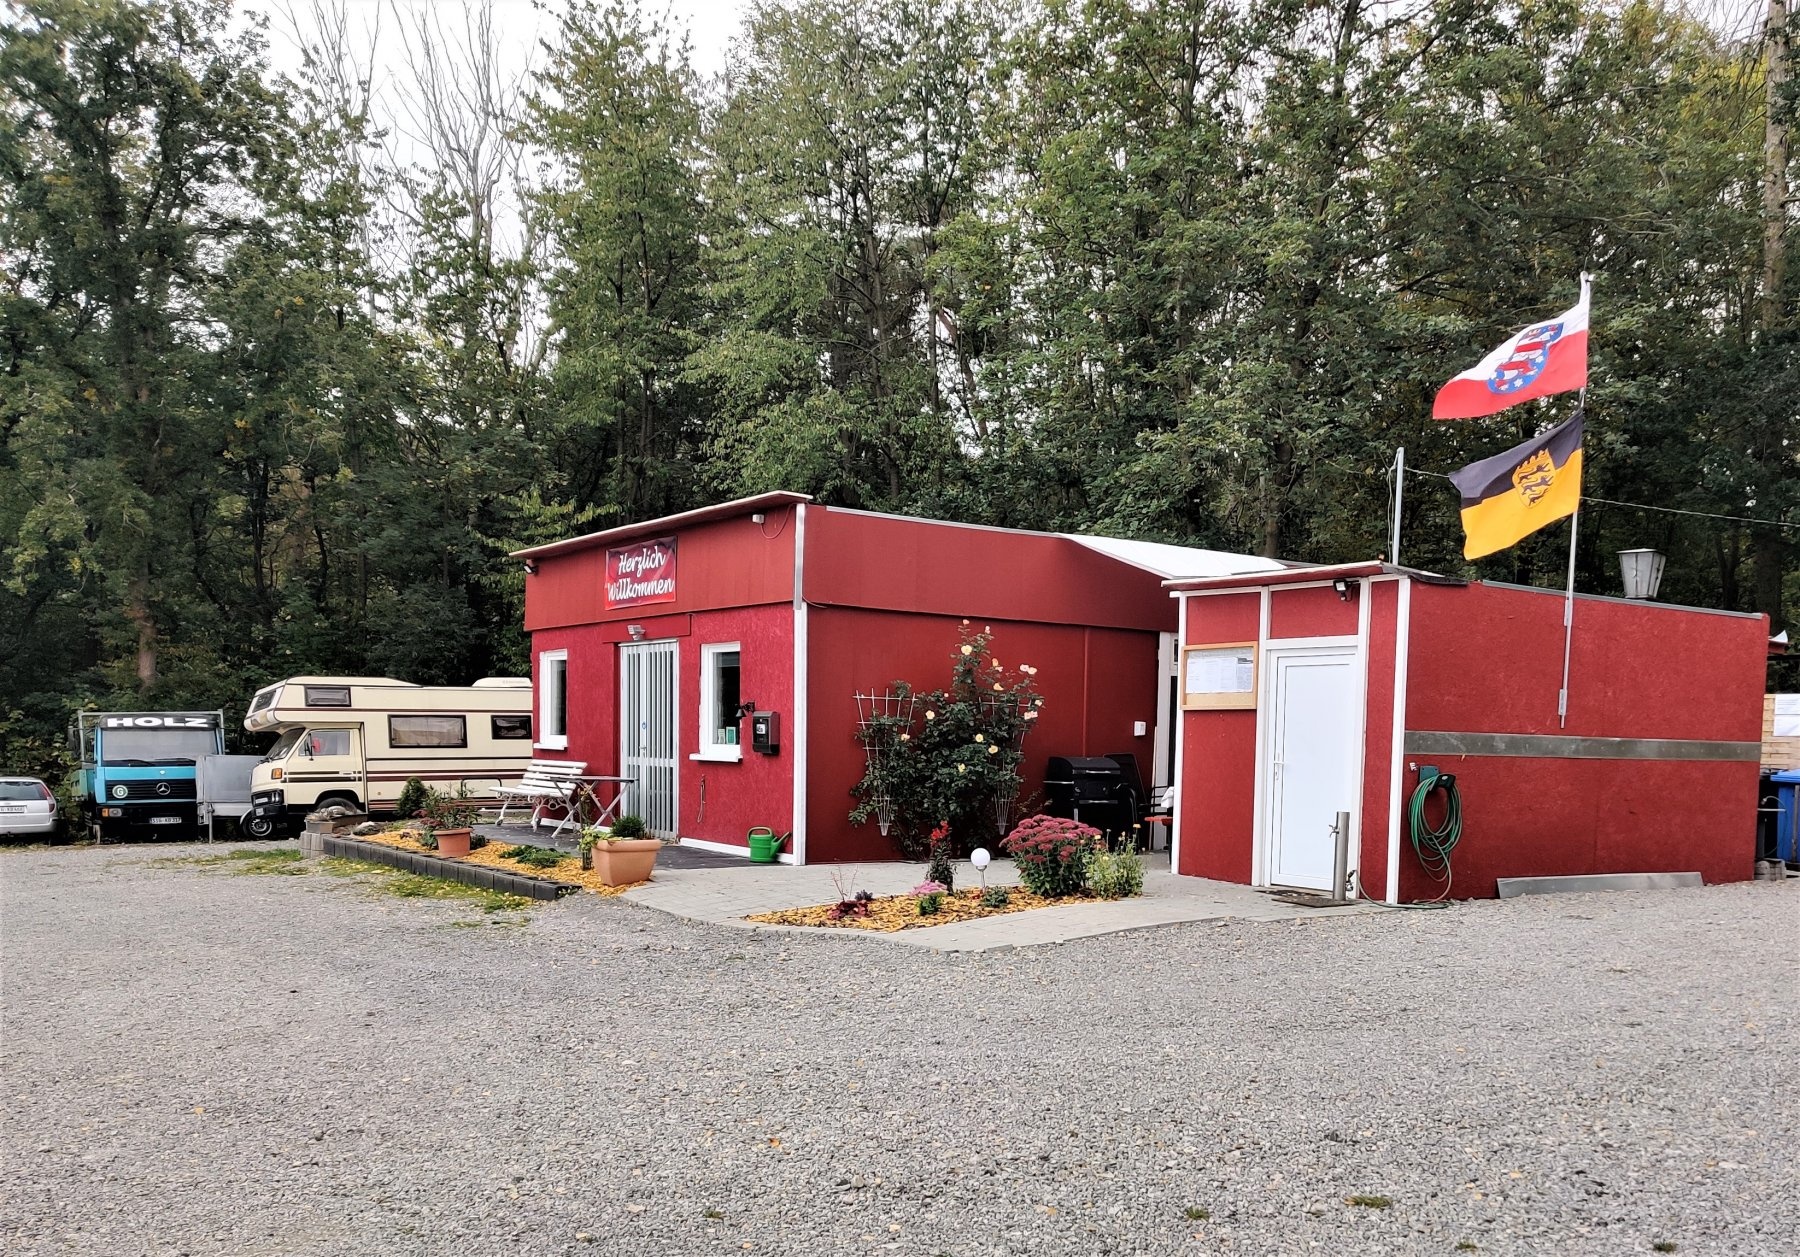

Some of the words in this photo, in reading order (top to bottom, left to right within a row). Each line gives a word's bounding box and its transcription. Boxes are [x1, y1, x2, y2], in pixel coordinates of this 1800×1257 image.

[618, 545, 666, 578] Herzlich
[607, 577, 675, 602] Willkommen
[107, 717, 208, 728] HOLZ
